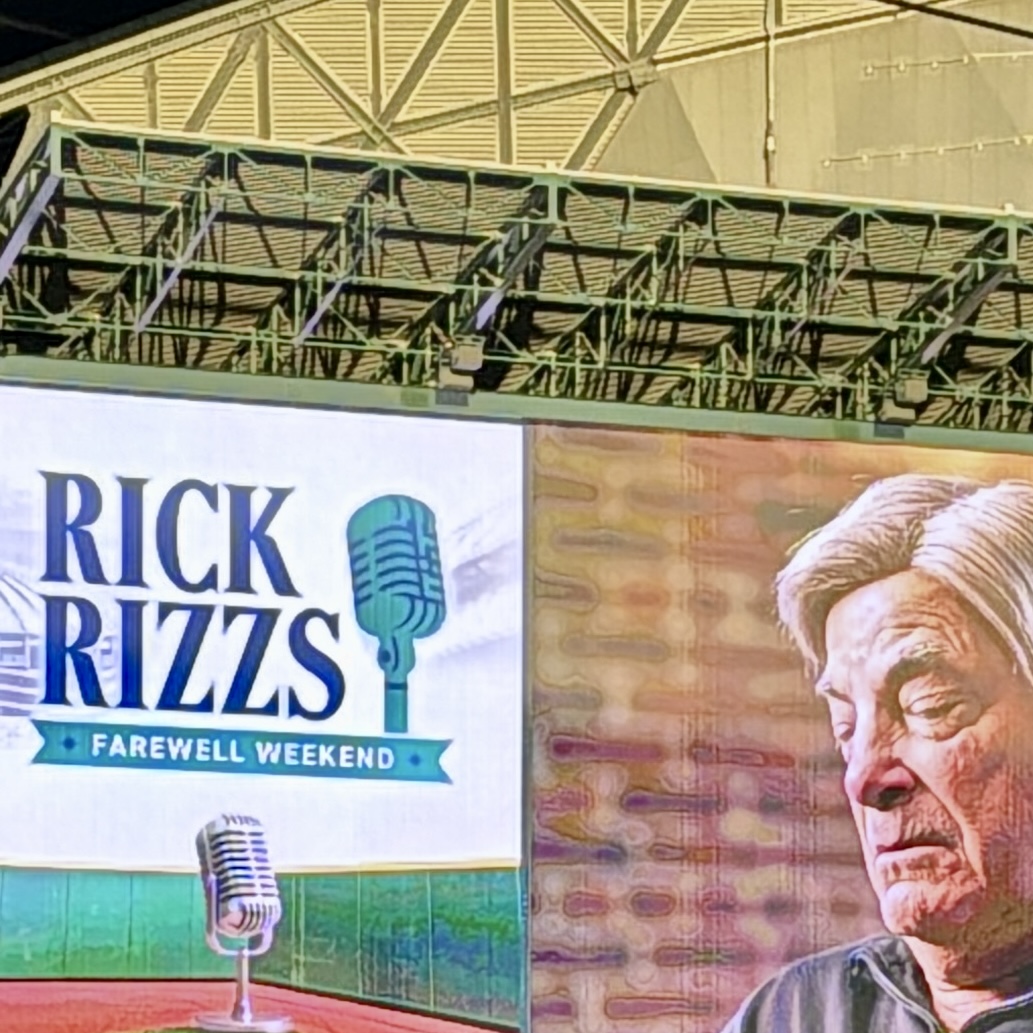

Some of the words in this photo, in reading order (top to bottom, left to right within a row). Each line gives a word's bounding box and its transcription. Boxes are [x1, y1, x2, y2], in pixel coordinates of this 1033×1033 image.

[37, 470, 303, 598] RICK
[38, 593, 346, 721] RIZZS
[91, 733, 245, 763] FAREWELL
[255, 741, 395, 770] WEEKEND
